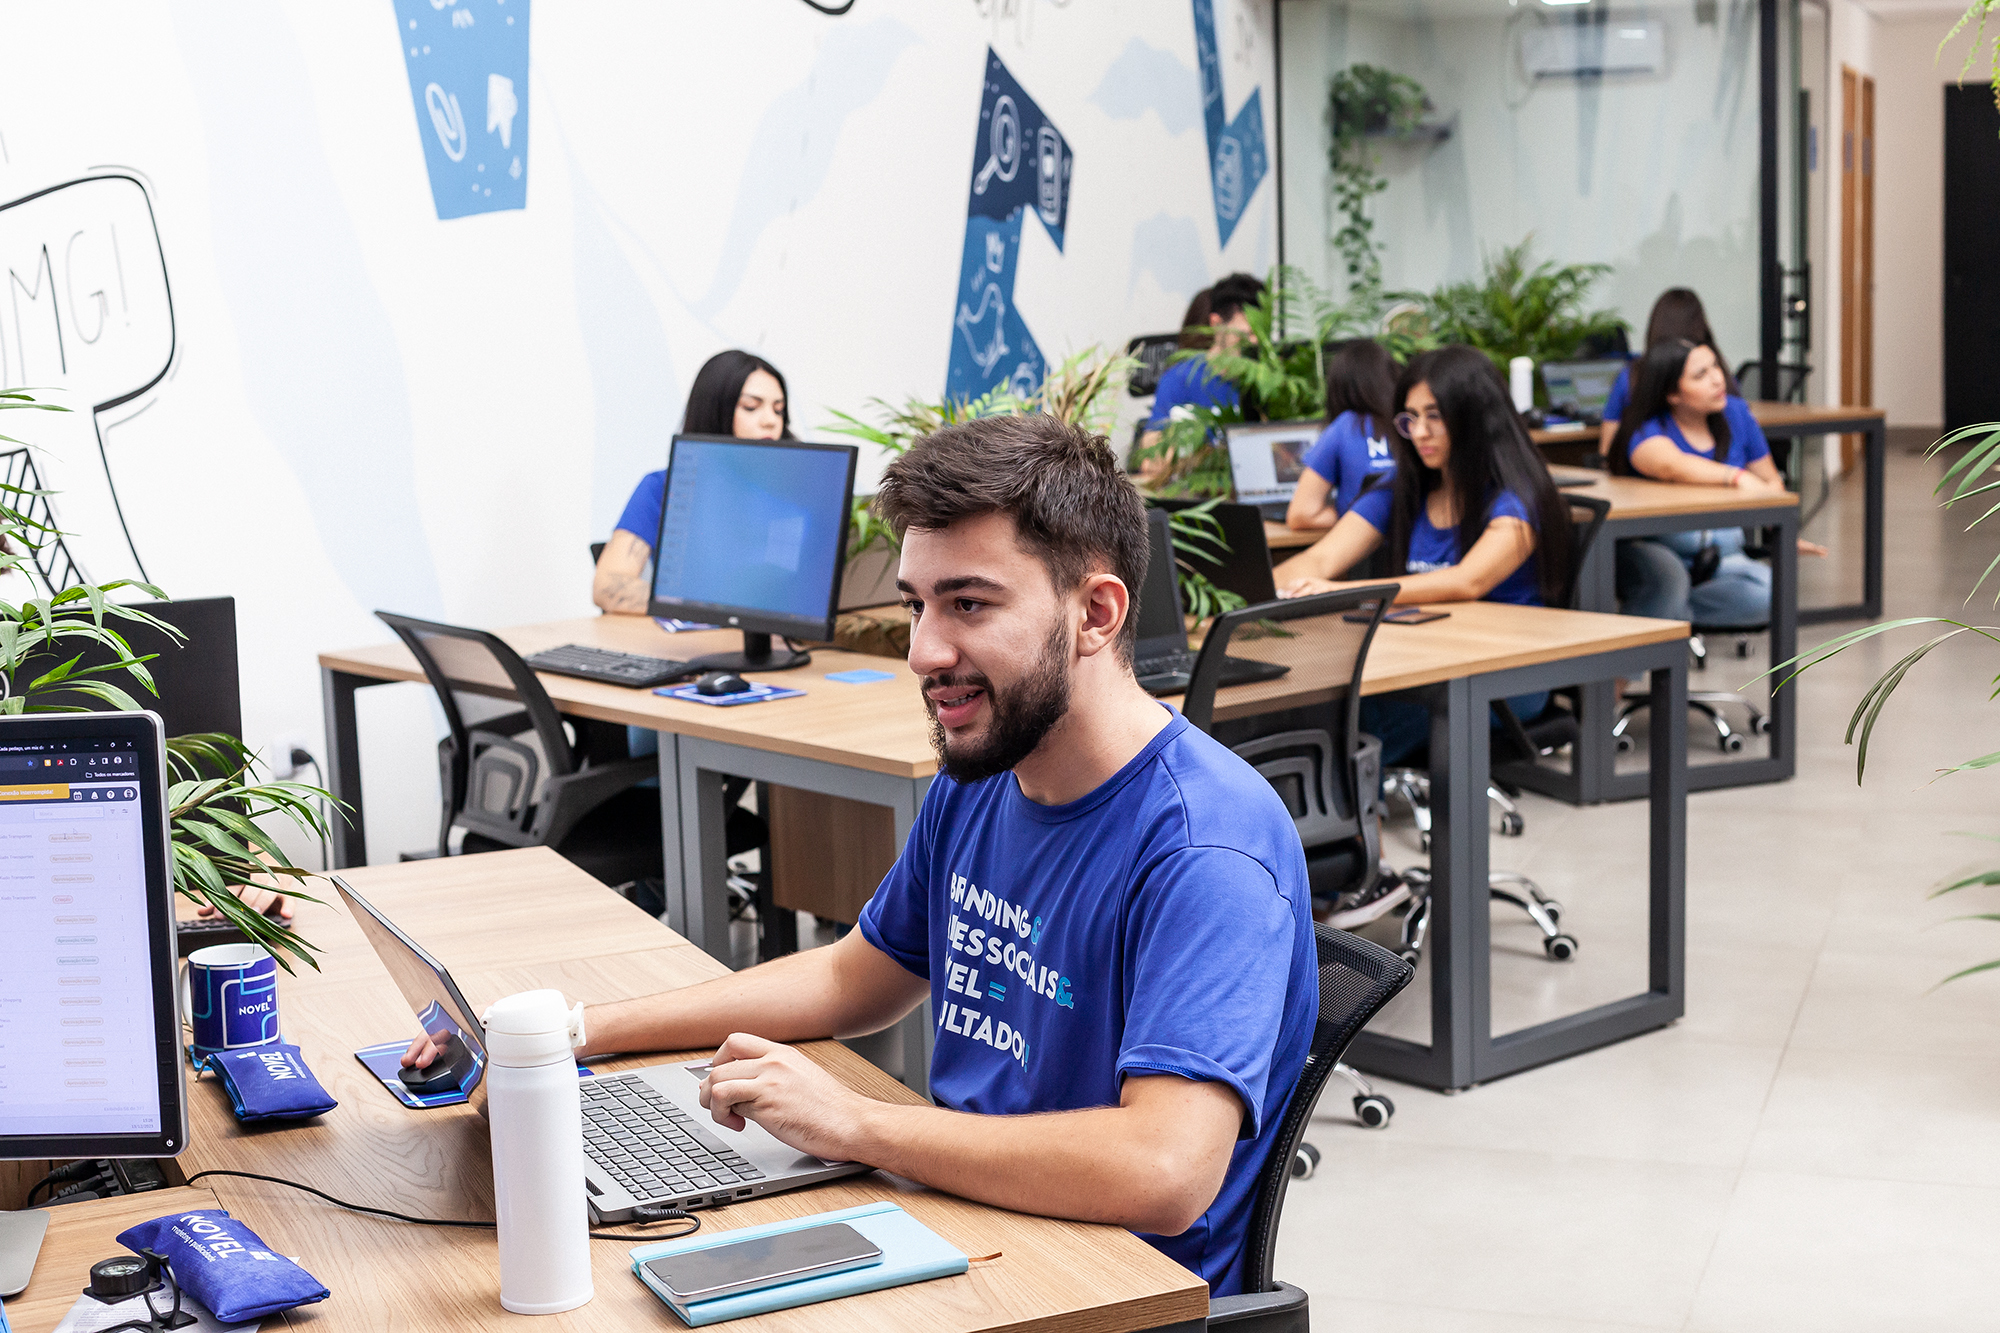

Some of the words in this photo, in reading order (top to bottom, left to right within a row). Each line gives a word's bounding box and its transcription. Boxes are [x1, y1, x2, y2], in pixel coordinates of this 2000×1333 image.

[0, 223, 130, 388] MG!
[239, 1002, 270, 1015] NOVEL
[258, 1051, 297, 1080] NOVEL
[180, 1215, 246, 1259] NOVEL
